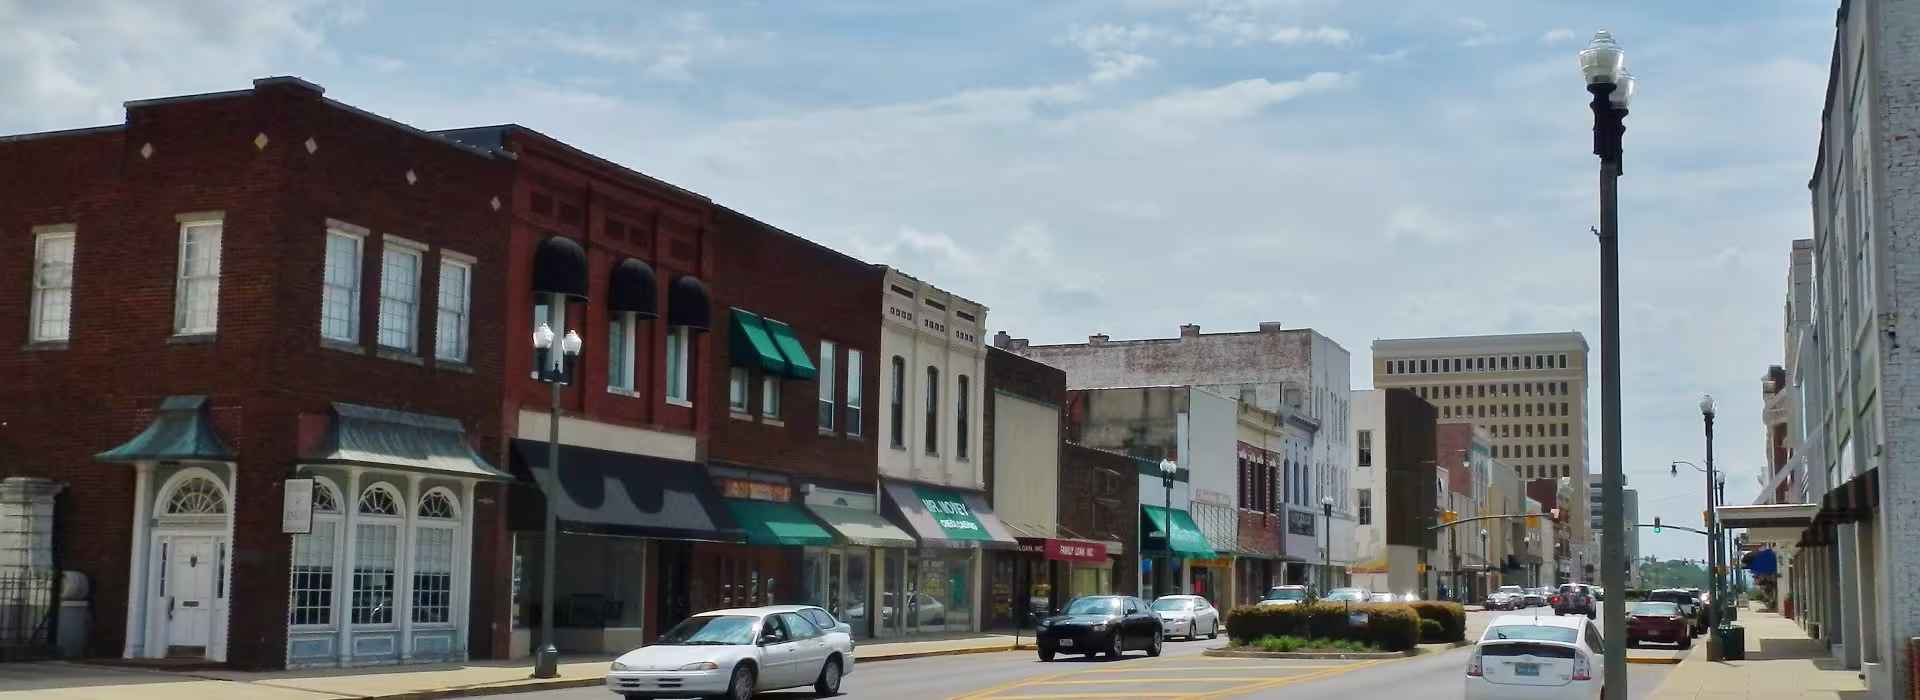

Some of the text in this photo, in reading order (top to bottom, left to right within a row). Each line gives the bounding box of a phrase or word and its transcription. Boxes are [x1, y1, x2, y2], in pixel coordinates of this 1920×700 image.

[922, 499, 968, 516] MR. MONEY
[1060, 545, 1074, 556] FAMILY
[1075, 546, 1085, 556] LOAN
